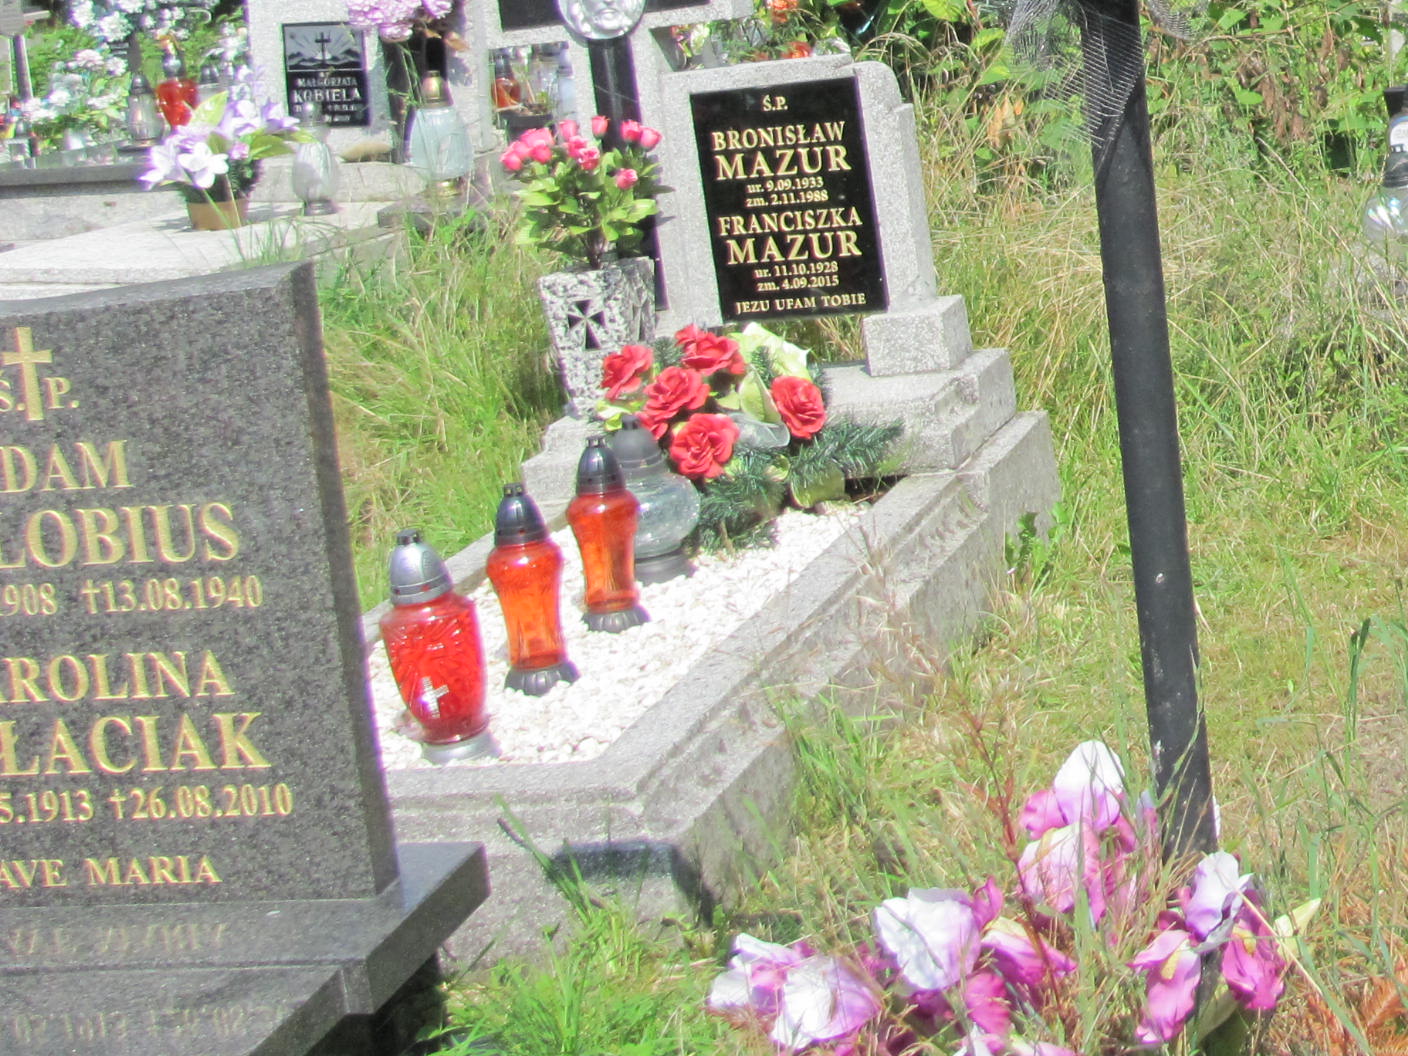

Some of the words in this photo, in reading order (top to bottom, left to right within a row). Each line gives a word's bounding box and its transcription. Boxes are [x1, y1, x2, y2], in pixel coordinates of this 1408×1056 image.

[294, 88, 361, 103] KOBIELA
[711, 120, 845, 151] BRONISŁAW
[714, 145, 851, 180] MAZUR
[746, 183, 765, 193] ur.
[766, 176, 824, 192] 9.09.1933
[746, 197, 769, 207] zm.
[770, 189, 829, 205] 2.11.1988
[718, 206, 862, 236] FRANCISZKA
[726, 230, 862, 265] MAZUR
[755, 267, 772, 278] ur.
[774, 260, 838, 277] 11.10.1928
[757, 280, 780, 292] zm.
[781, 275, 839, 290] 4.09.2015
[735, 300, 770, 314] JEZU
[775, 296, 816, 312] UFAM
[821, 293, 866, 307] TOBIE
[0, 649, 236, 703] ROLINA
[0, 859, 67, 889] AVE
[83, 855, 223, 887] MARIA
